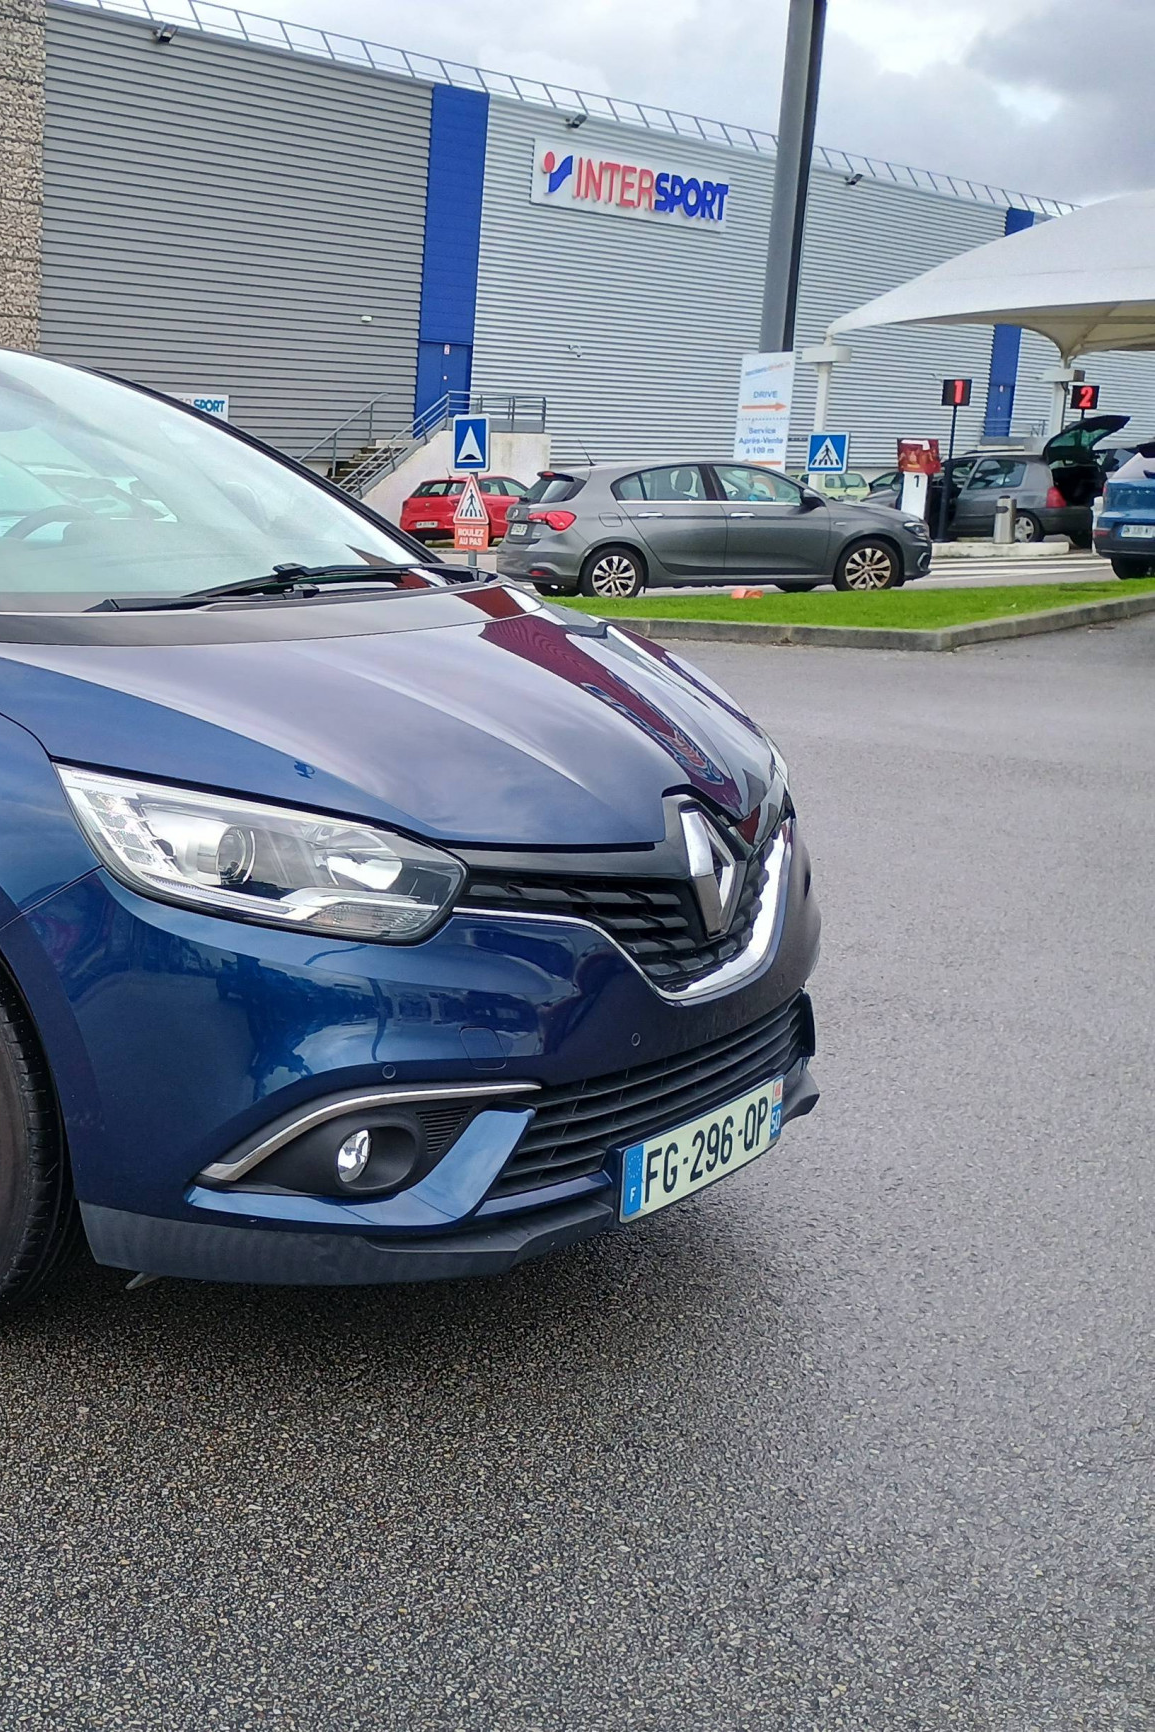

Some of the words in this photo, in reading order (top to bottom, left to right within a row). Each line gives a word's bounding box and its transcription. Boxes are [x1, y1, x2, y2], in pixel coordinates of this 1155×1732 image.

[575, 157, 729, 220] INTERSPORT
[753, 390, 778, 399] DRIVE
[954, 380, 964, 404] 1
[1079, 386, 1093, 407] 2
[914, 475, 919, 487] 1
[457, 528, 484, 537] ROULEZ
[459, 537, 468, 545] AU
[469, 537, 482, 546] PAS
[644, 1096, 769, 1204] FG-296-QP
[629, 1187, 636, 1203] F
